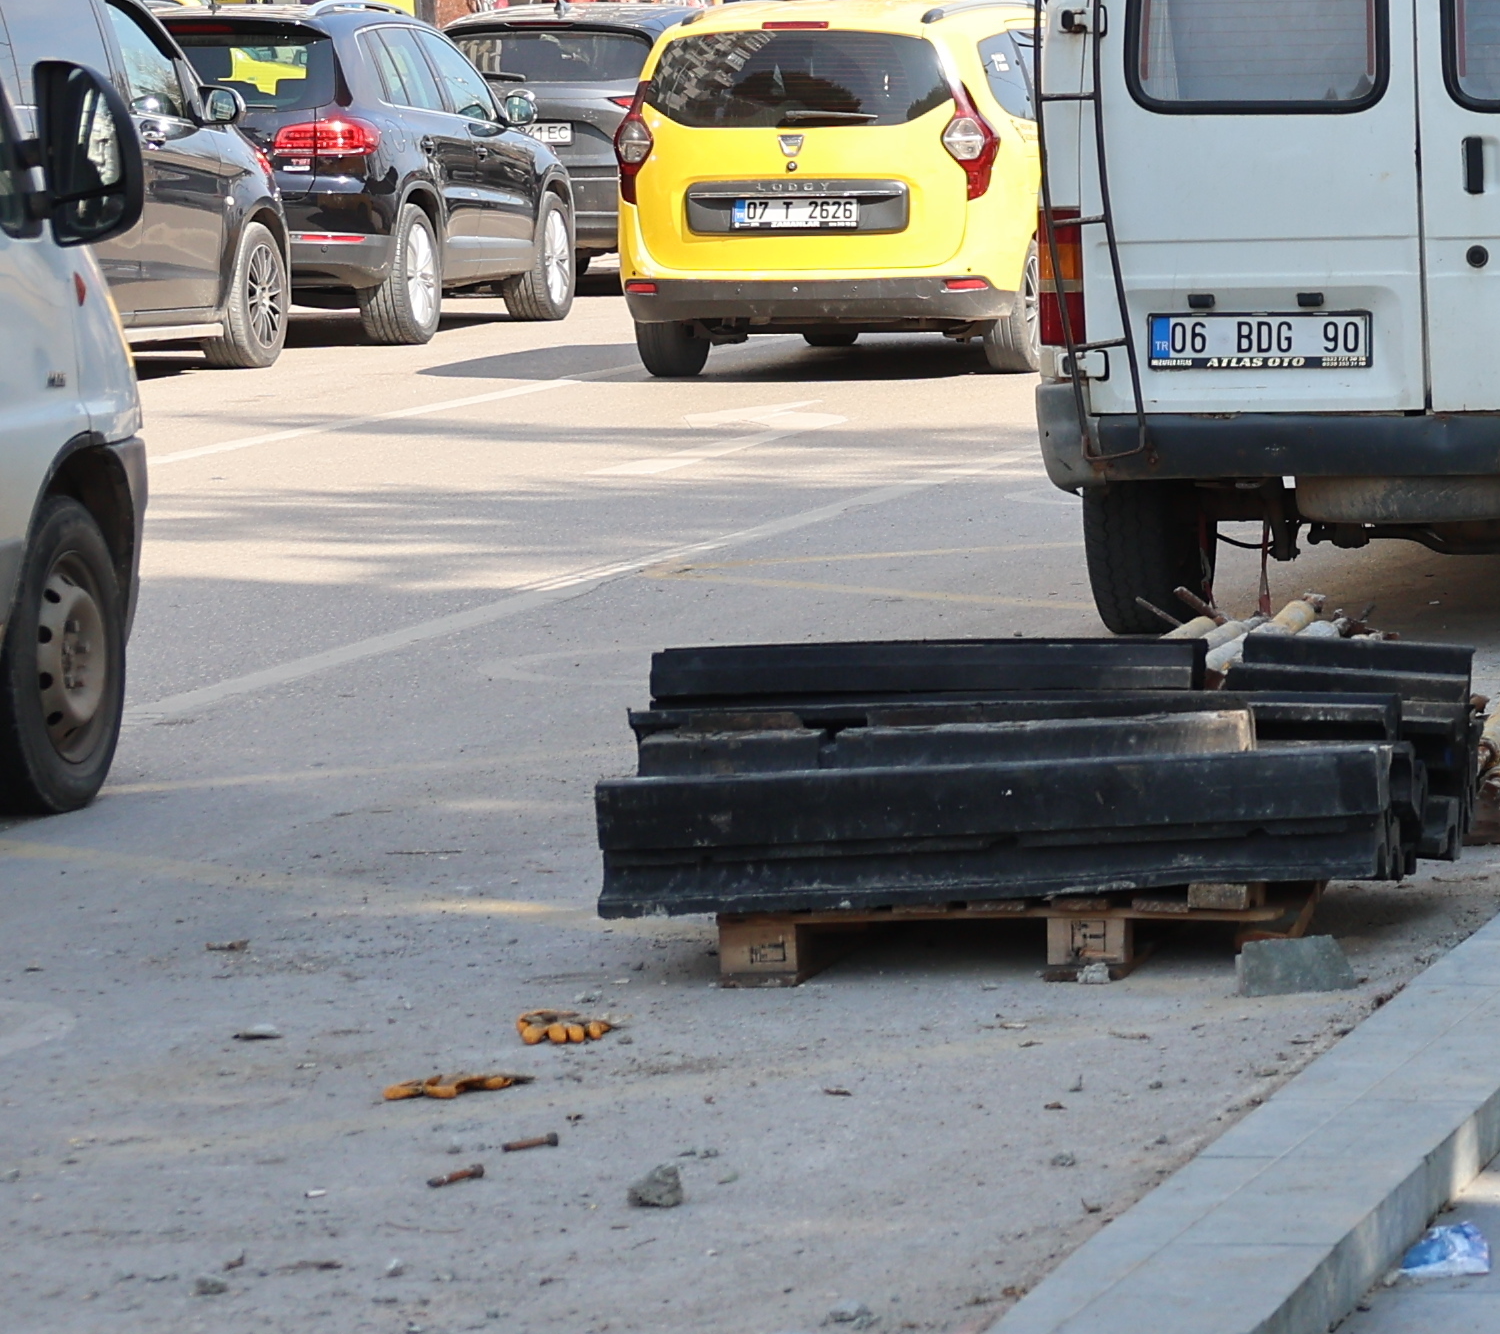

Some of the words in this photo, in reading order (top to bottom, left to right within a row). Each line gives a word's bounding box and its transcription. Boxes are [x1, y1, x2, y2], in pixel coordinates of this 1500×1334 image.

[548, 123, 570, 140] EC
[747, 201, 769, 220] 07
[783, 201, 793, 219] T
[808, 201, 853, 220] 2626
[771, 220, 821, 228] ZAMANLAR
[1155, 341, 1169, 352] TR
[1171, 321, 1207, 354] 06
[1236, 320, 1293, 354] BDG
[1322, 320, 1360, 354] 90
[1206, 357, 1264, 367] ATLAS
[1267, 357, 1306, 367] OTO
